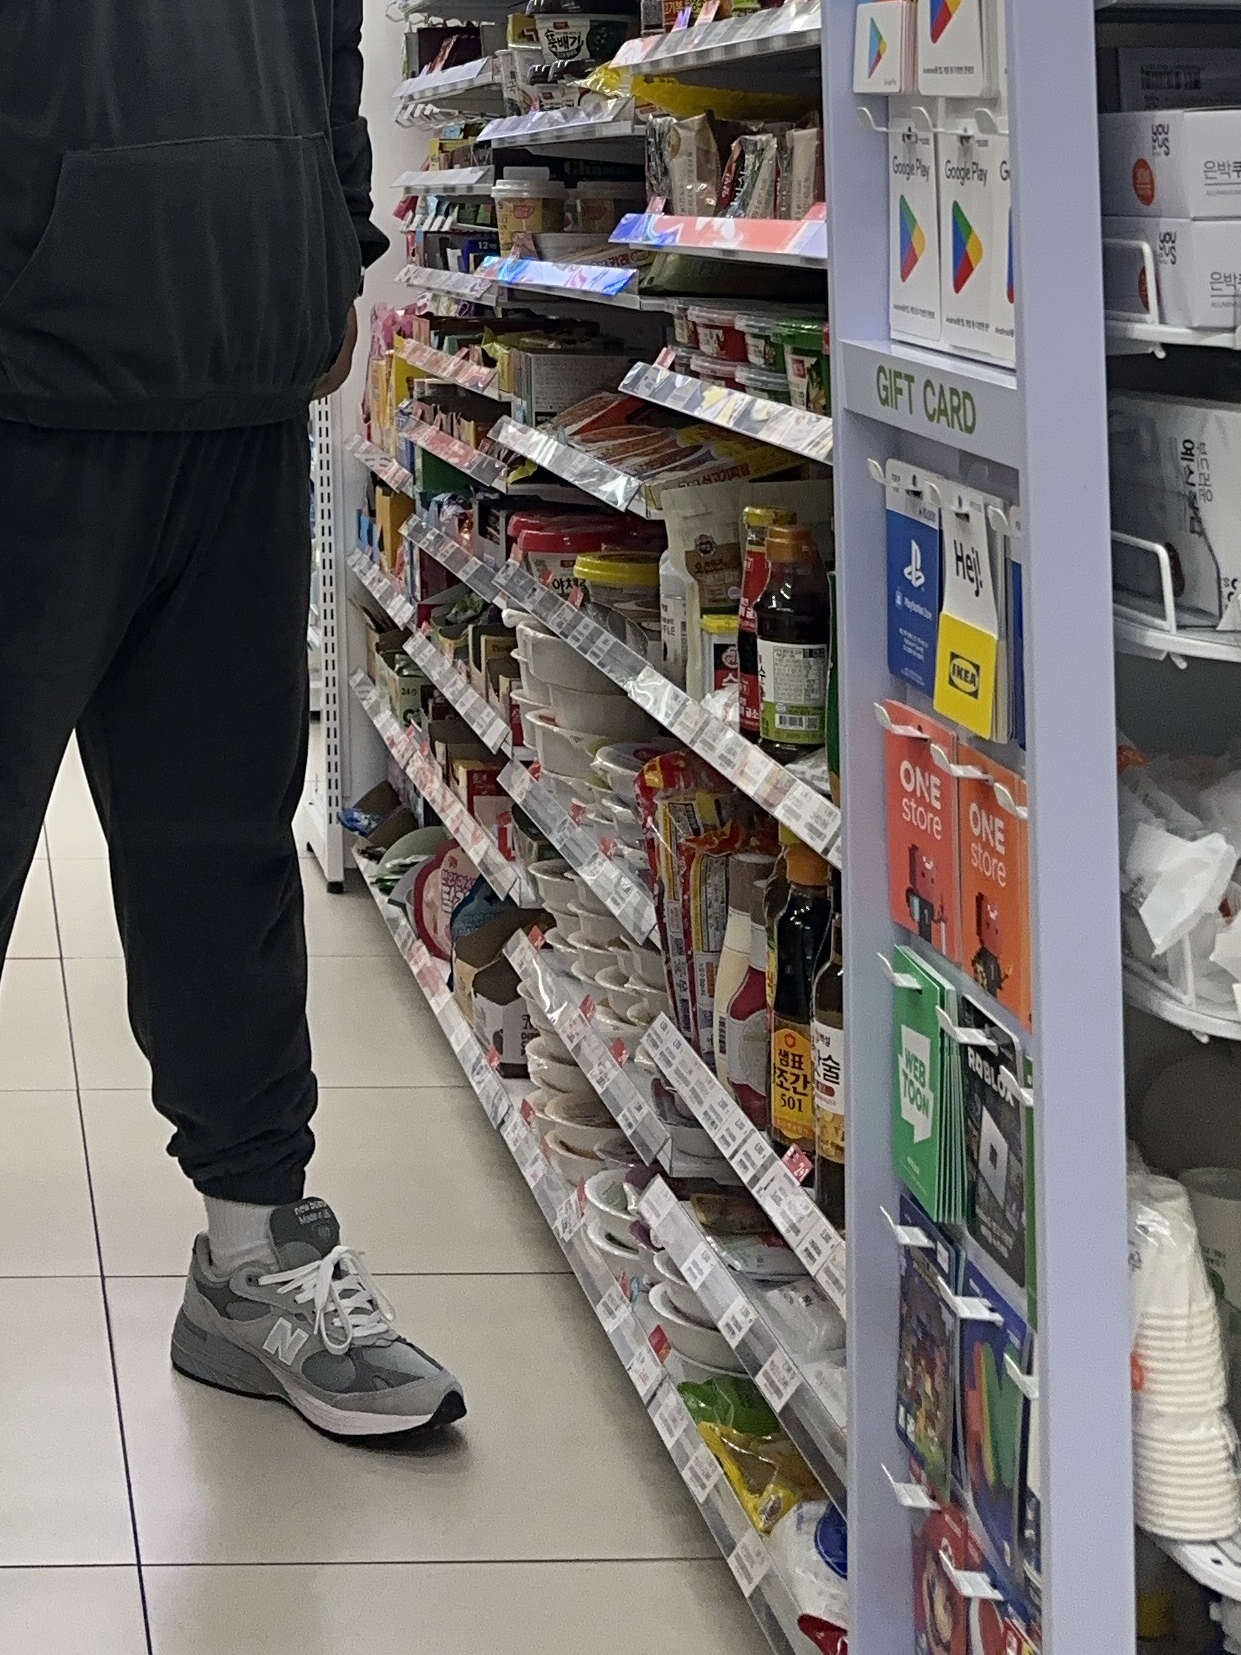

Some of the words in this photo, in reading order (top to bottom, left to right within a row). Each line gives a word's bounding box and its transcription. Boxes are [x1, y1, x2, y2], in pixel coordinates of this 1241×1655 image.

[892, 155, 915, 177] Google
[915, 157, 930, 183] Play
[944, 159, 971, 187] Google
[971, 161, 988, 187] Play
[1209, 270, 1241, 292] 은박
[876, 364, 916, 416] GIFT
[922, 378, 977, 435] CARD
[953, 539, 984, 597] Hej!
[951, 660, 978, 687] IKEA
[899, 760, 942, 811] ONE
[901, 797, 943, 841] store
[969, 802, 1006, 856] ONE
[970, 842, 1007, 889] store
[778, 1048, 805, 1072] 샘표
[904, 1046, 927, 1087] WEB
[773, 1067, 810, 1097] 조간
[781, 1093, 804, 1113] 501
[902, 1069, 930, 1119] TOON
[263, 1316, 310, 1366] N
